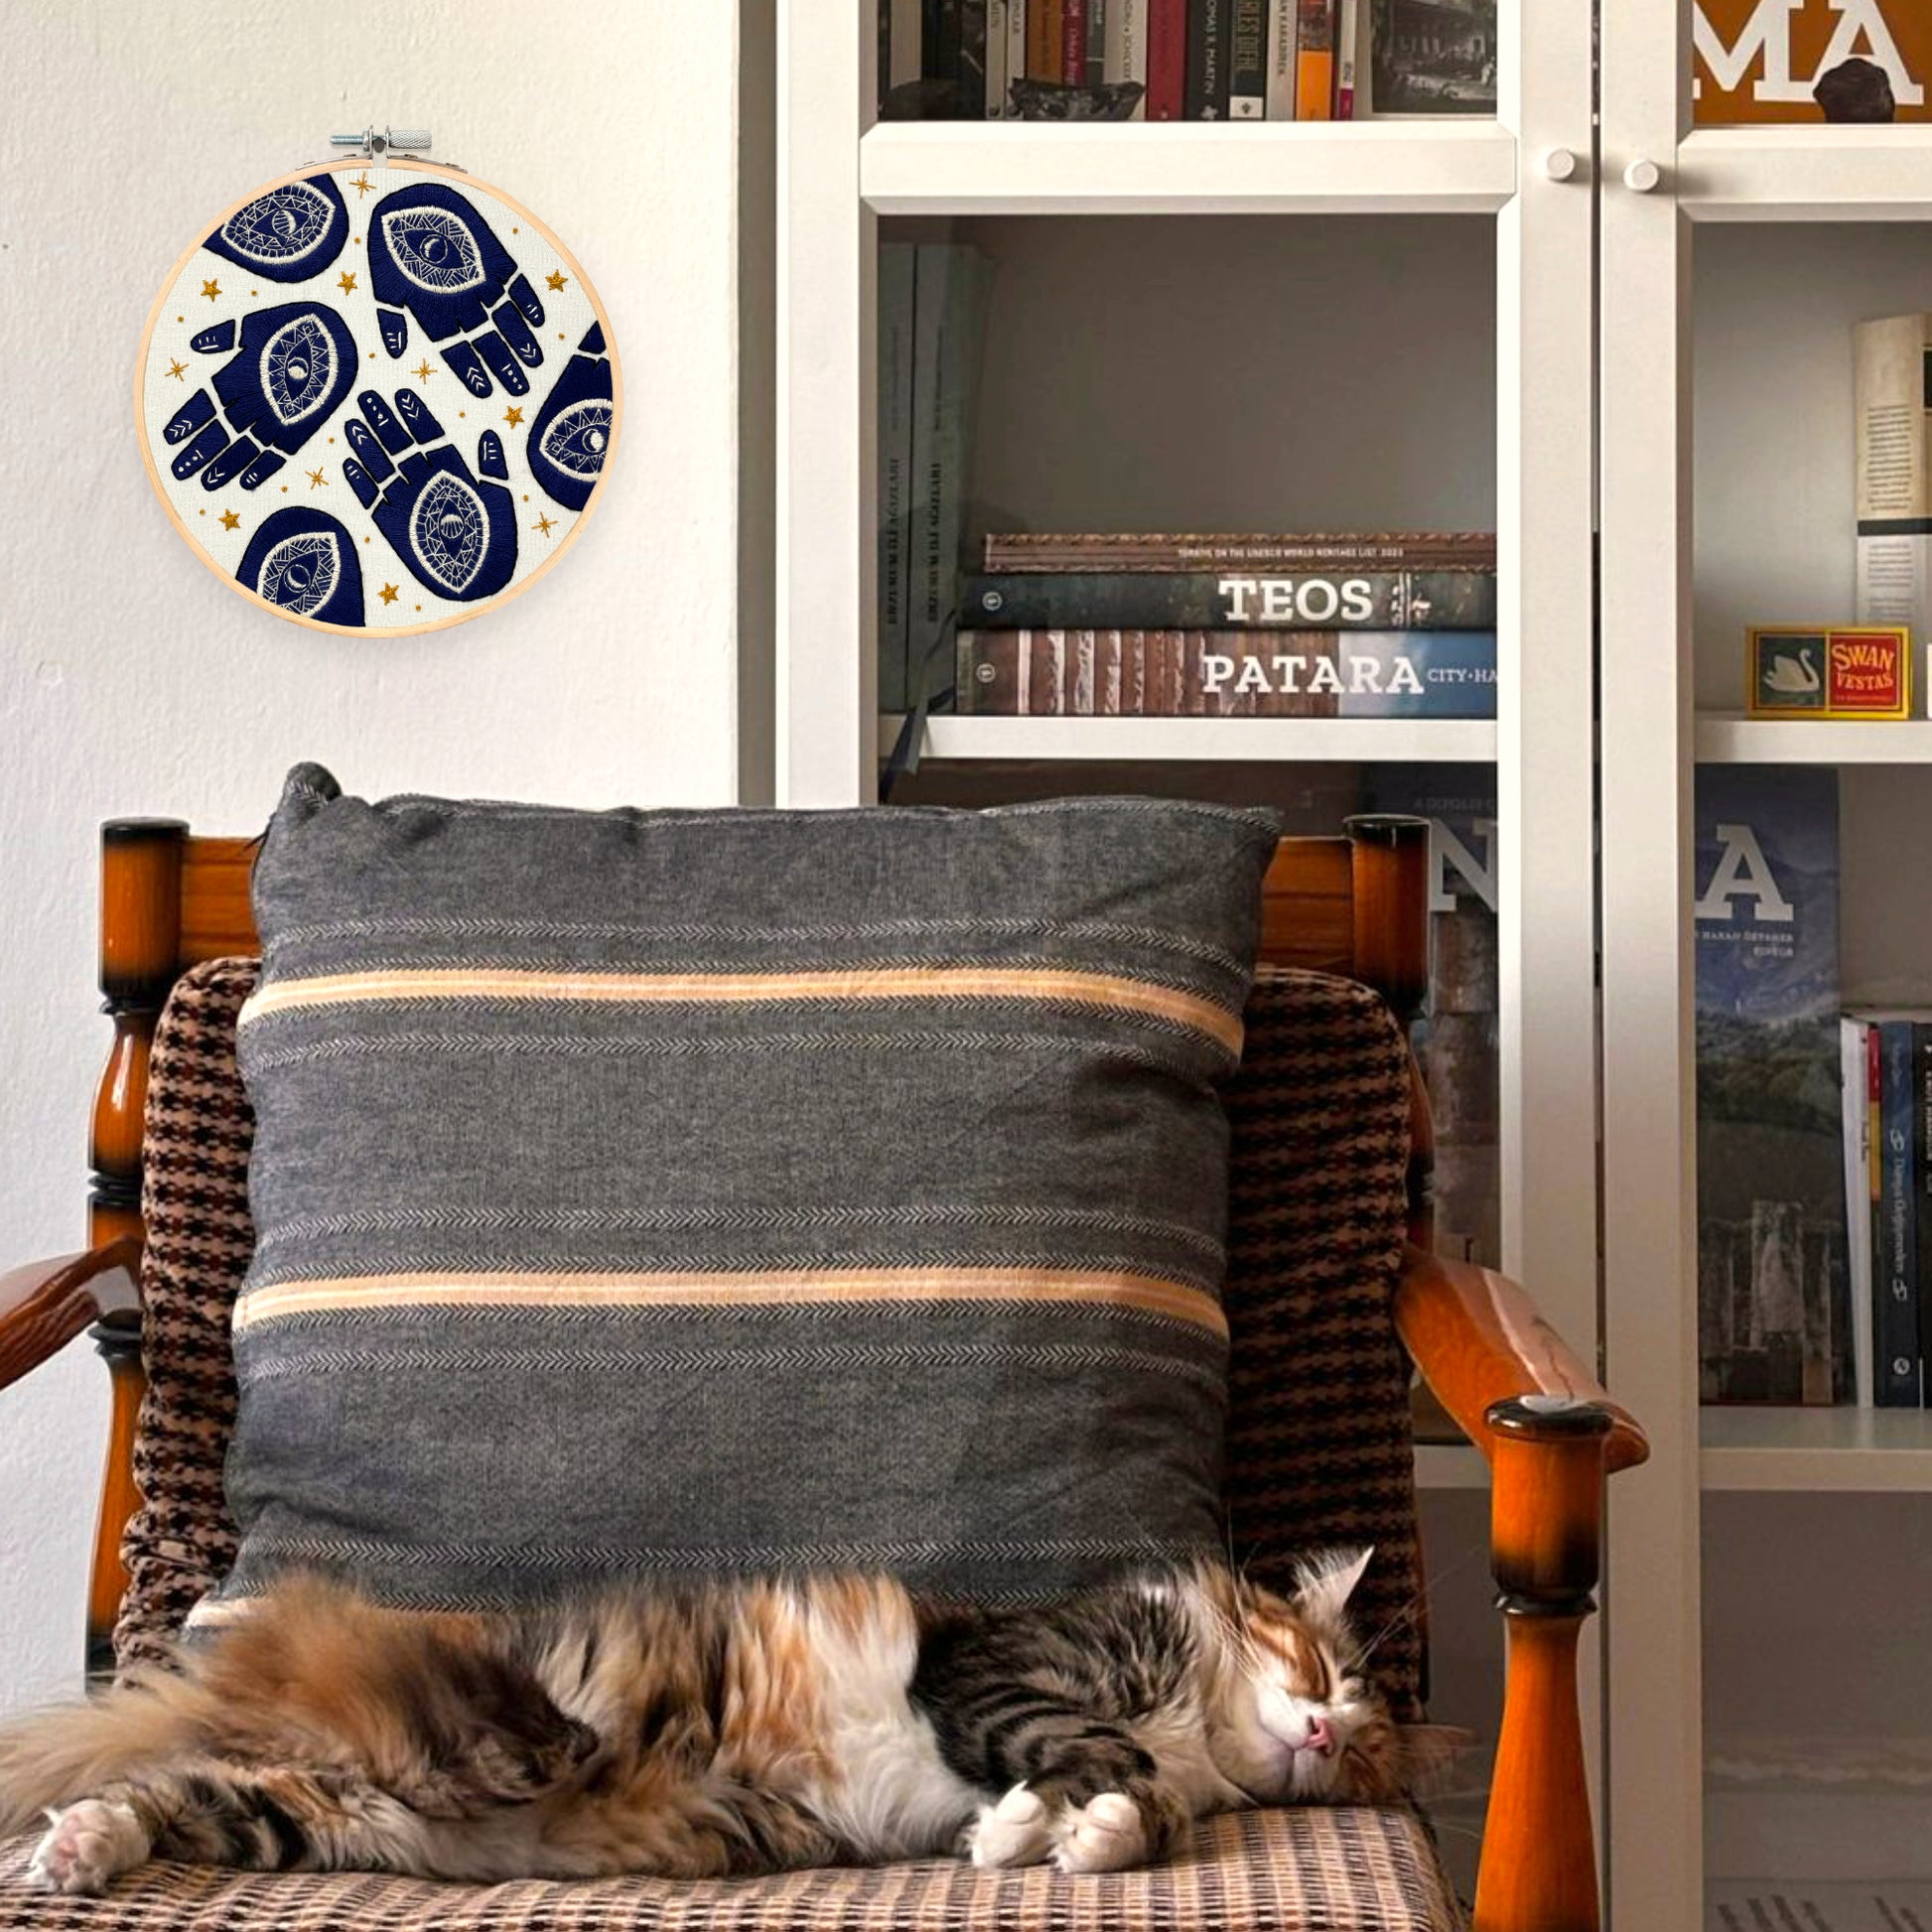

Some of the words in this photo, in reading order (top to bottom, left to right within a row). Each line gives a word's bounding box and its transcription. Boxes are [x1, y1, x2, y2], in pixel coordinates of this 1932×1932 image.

[1204, 48, 1217, 95] MARTIN
[1229, 547, 1245, 557] THE
[1247, 547, 1282, 557] UNESCO
[1284, 547, 1314, 557] WORLD
[1316, 547, 1356, 557] HERITAGE
[1358, 547, 1377, 557] LIST
[1218, 580, 1373, 621] TEOS
[1831, 643, 1895, 672] SWAN
[1202, 655, 1425, 695] PATARA
[1837, 672, 1894, 691] VESTAS
